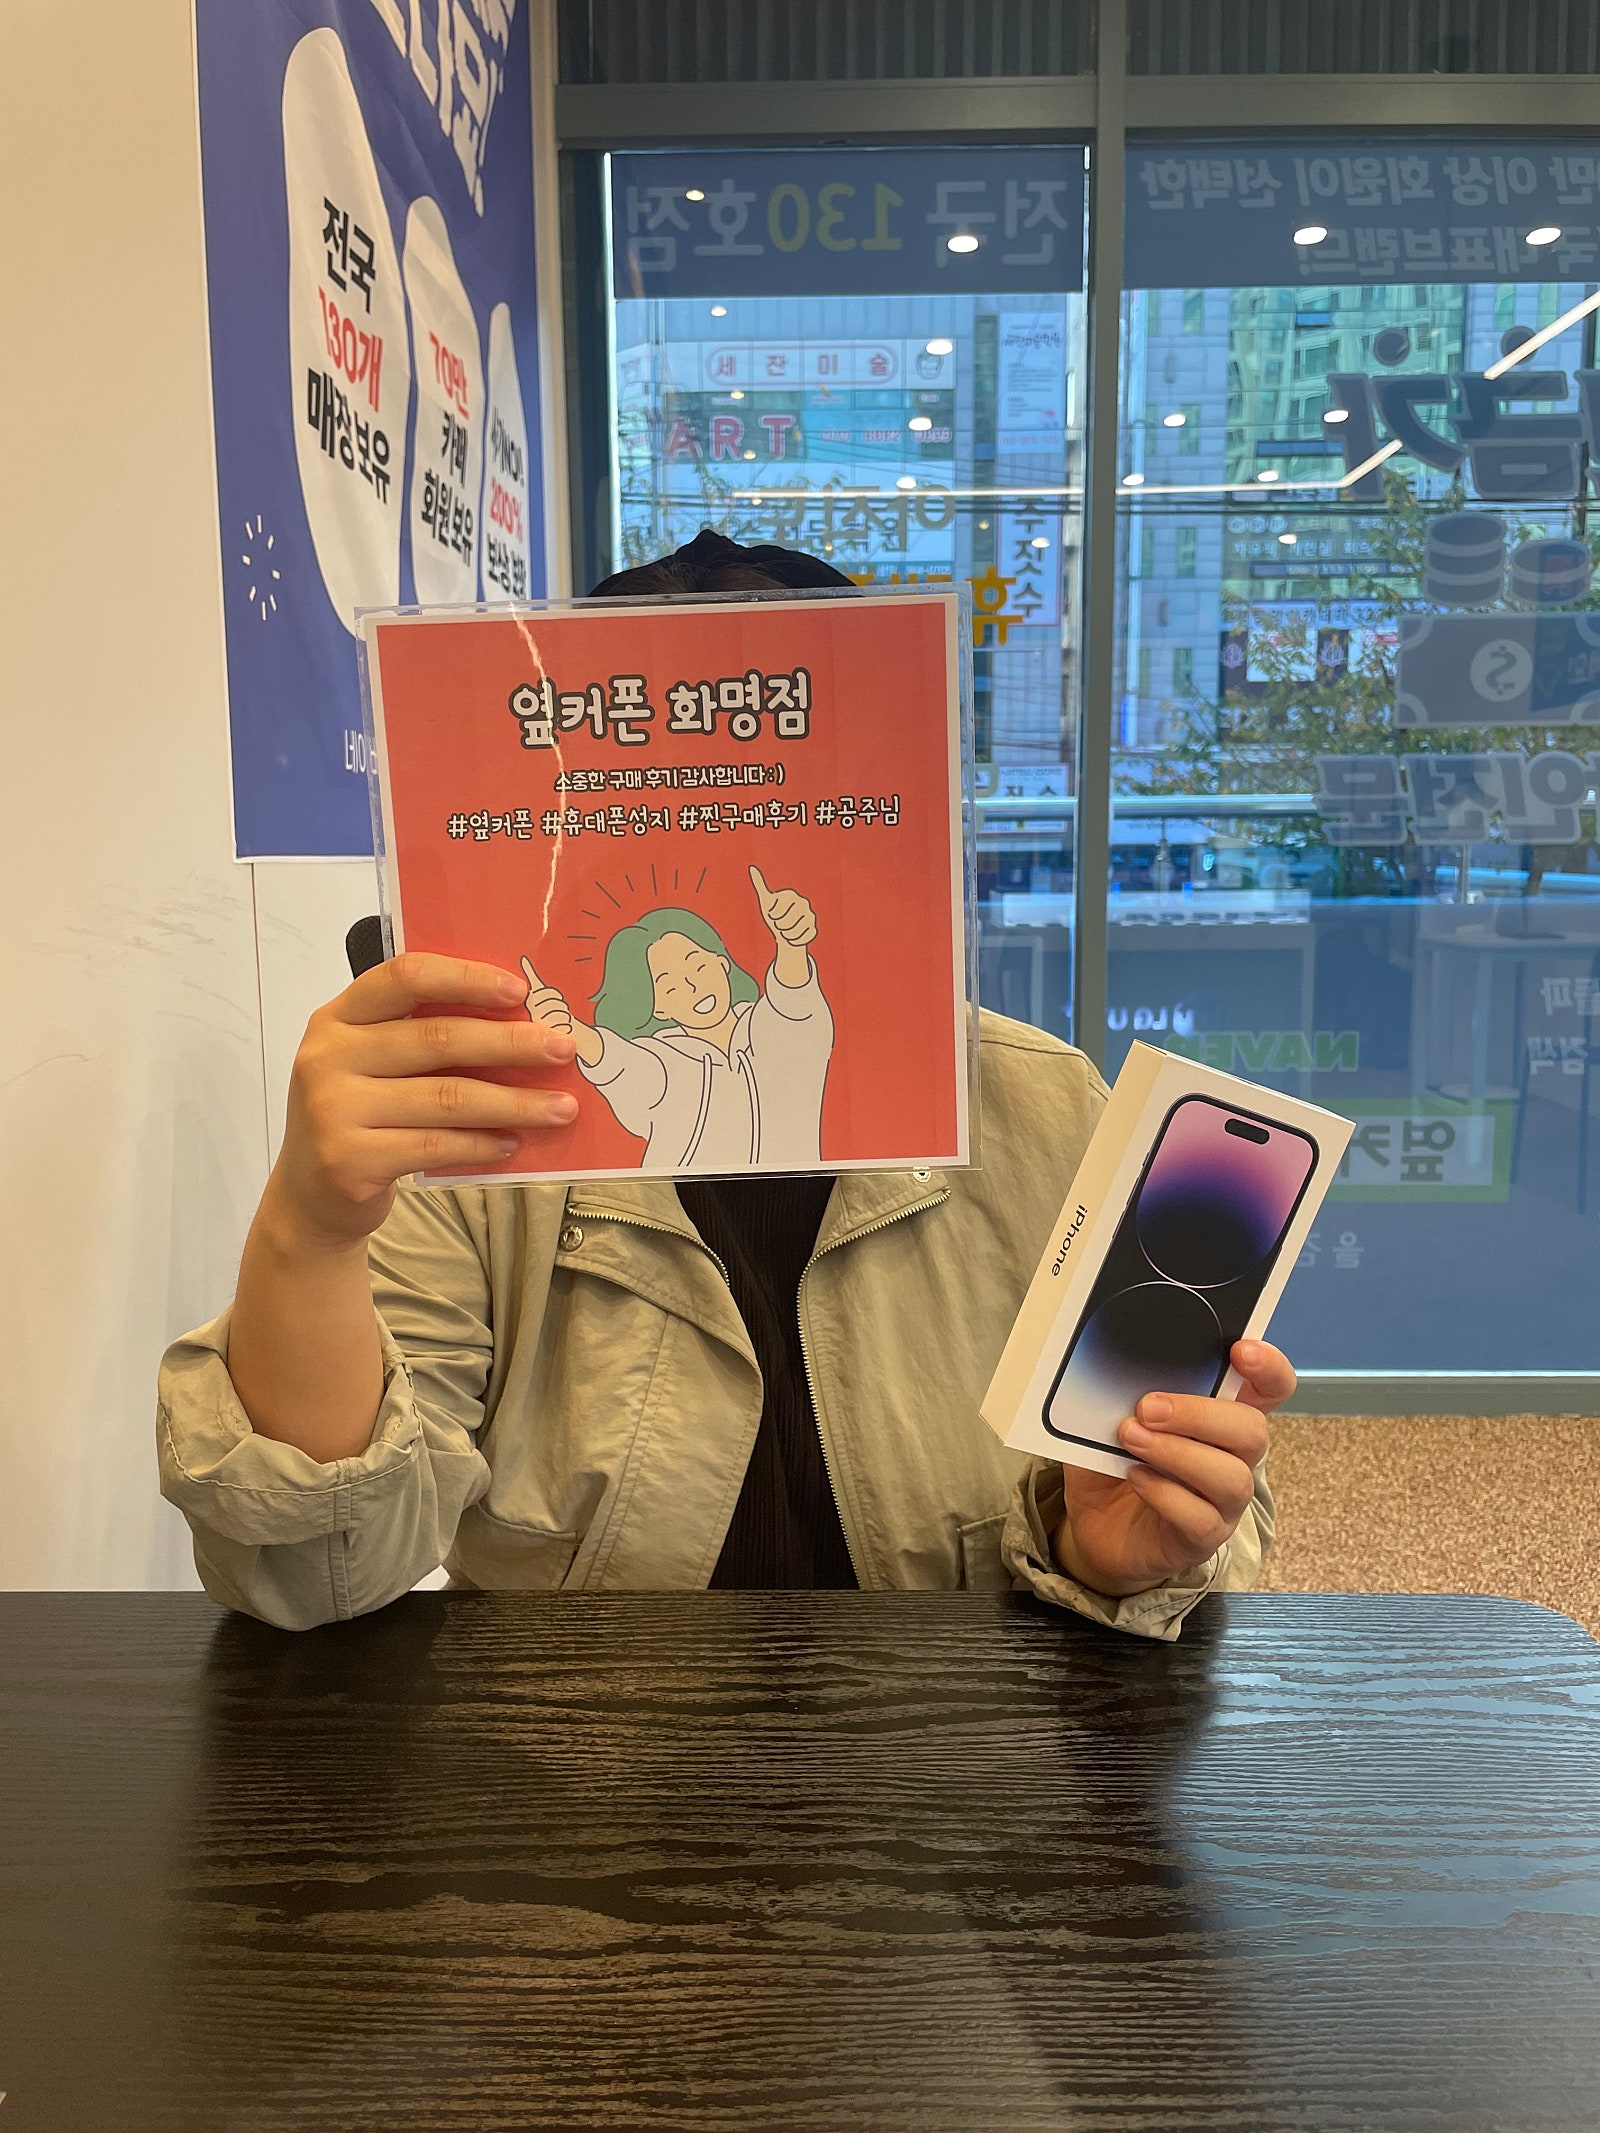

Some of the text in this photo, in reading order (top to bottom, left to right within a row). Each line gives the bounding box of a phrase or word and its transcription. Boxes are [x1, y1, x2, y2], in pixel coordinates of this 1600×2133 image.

[322, 196, 377, 315] 전국
[317, 285, 384, 413] 130개
[428, 330, 470, 421] 70만
[306, 366, 392, 505] 매장보유
[441, 410, 470, 490] 카페
[666, 415, 797, 461] ART
[420, 467, 475, 568] 회원보유
[1012, 497, 1047, 618] 주짓수
[509, 667, 813, 749] 옆커폰 화명점
[446, 794, 902, 842] #옆커폰 #휴대폰성지 #찐구매후기 #공주님
[554, 769, 606, 792] 소중한
[608, 767, 643, 790] 구매
[645, 766, 678, 789] 후기
[1051, 1204, 1088, 1276] iPhone
